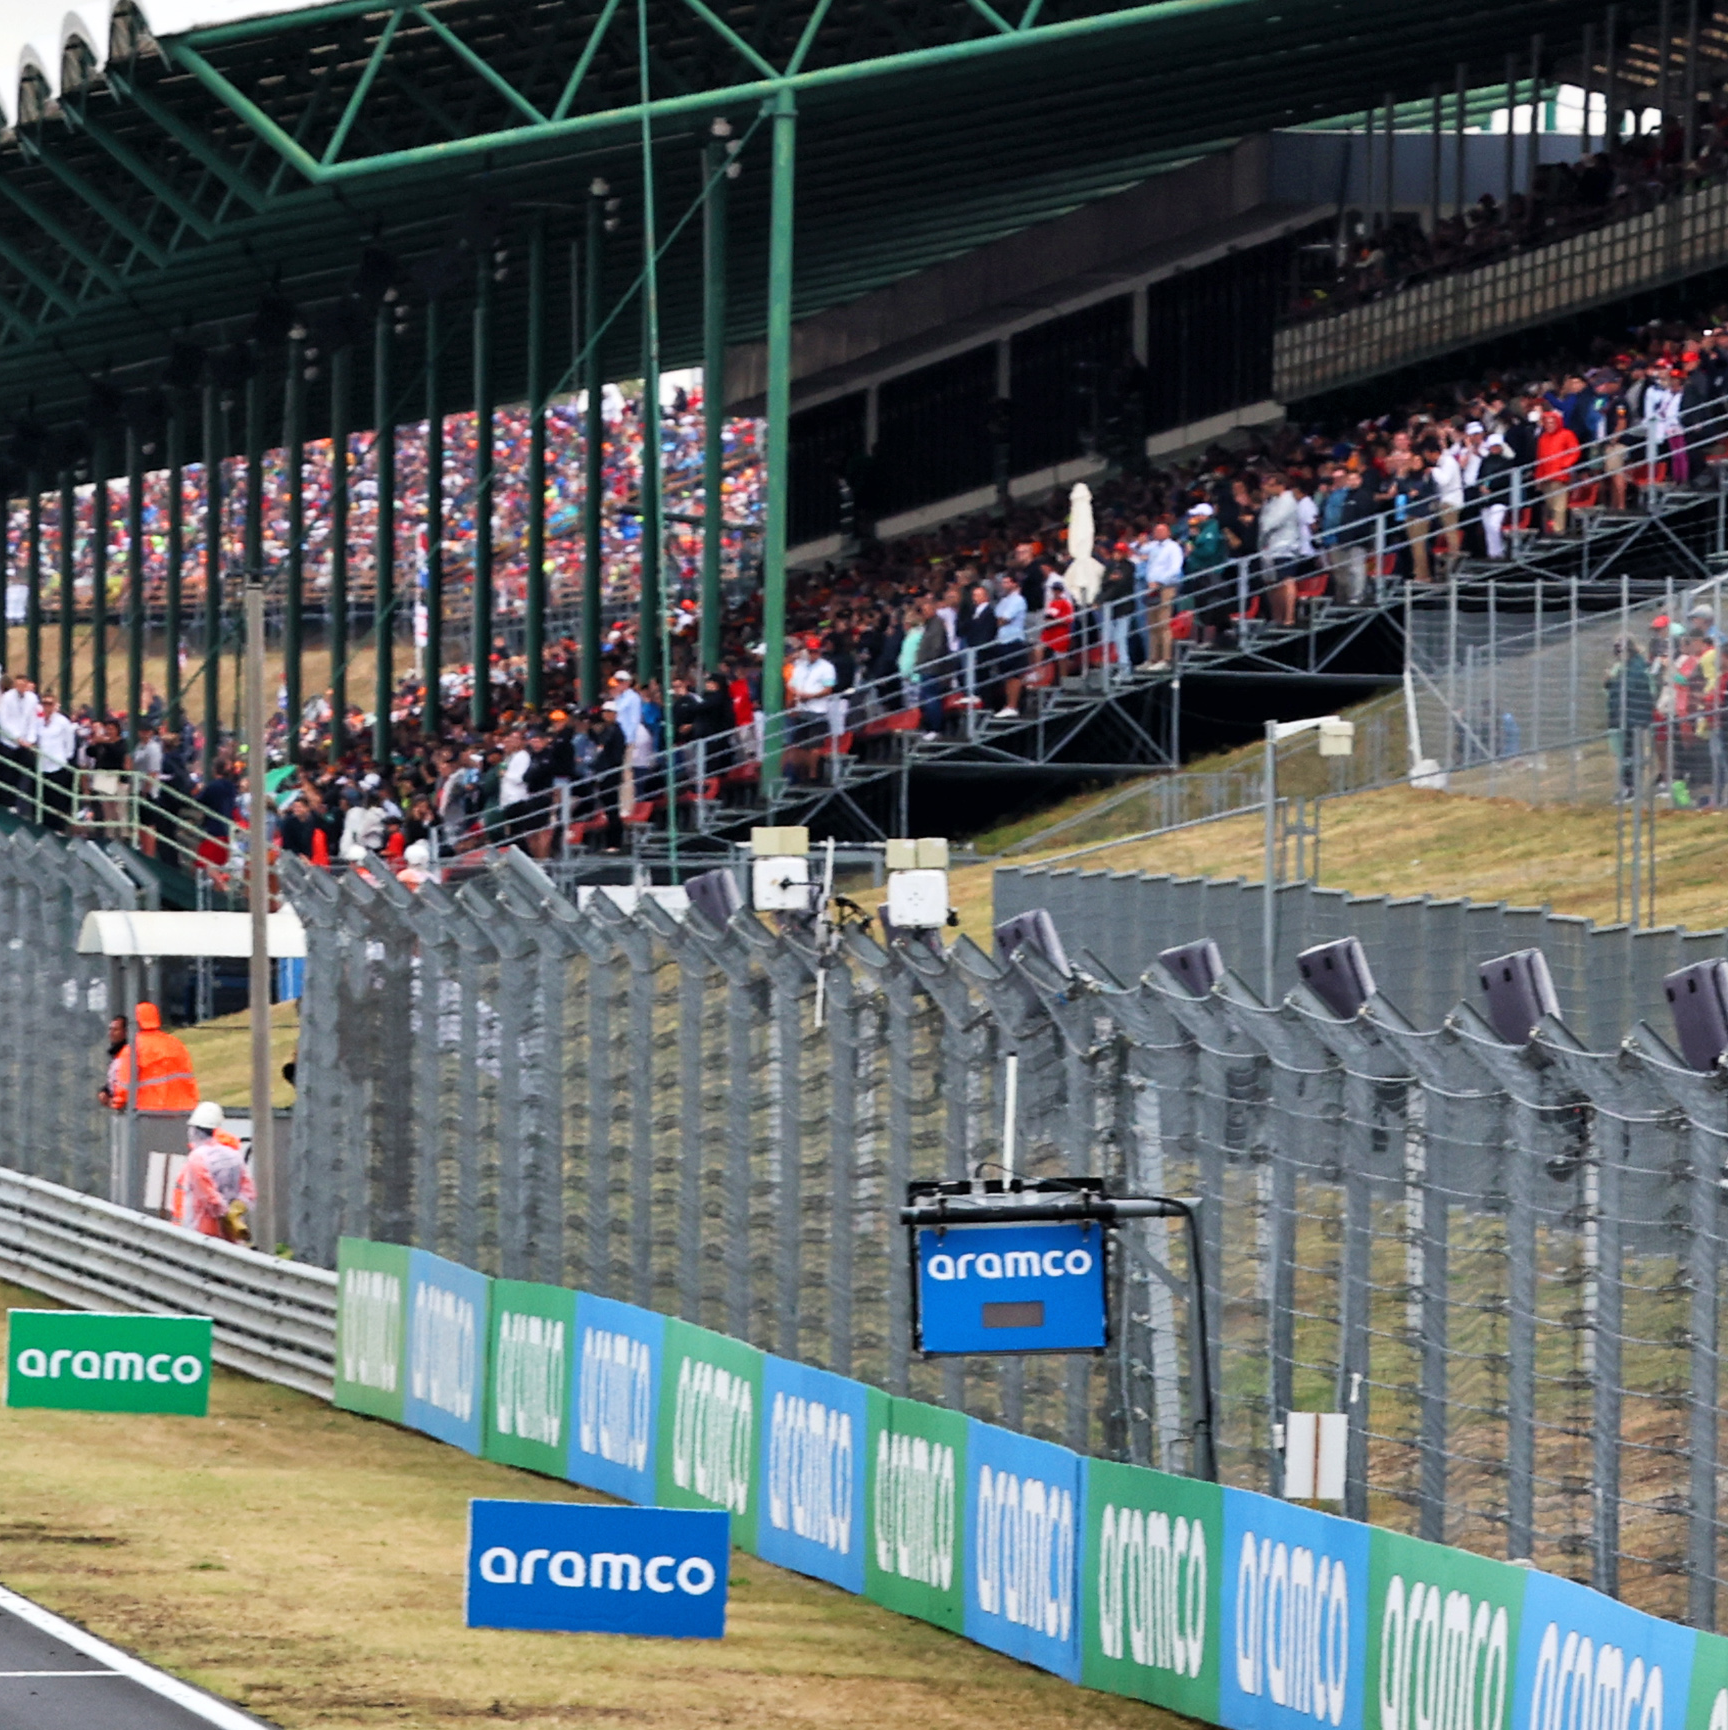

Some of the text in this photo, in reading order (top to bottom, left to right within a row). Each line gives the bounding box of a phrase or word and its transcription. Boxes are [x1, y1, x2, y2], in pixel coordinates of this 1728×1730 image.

[927, 1249, 1092, 1281] aramco
[17, 1348, 202, 1384] aramco
[479, 1547, 715, 1595] aramco
[976, 1463, 1072, 1642] aramco
[1099, 1503, 1206, 1679] aramco
[1236, 1531, 1348, 1727] aramco
